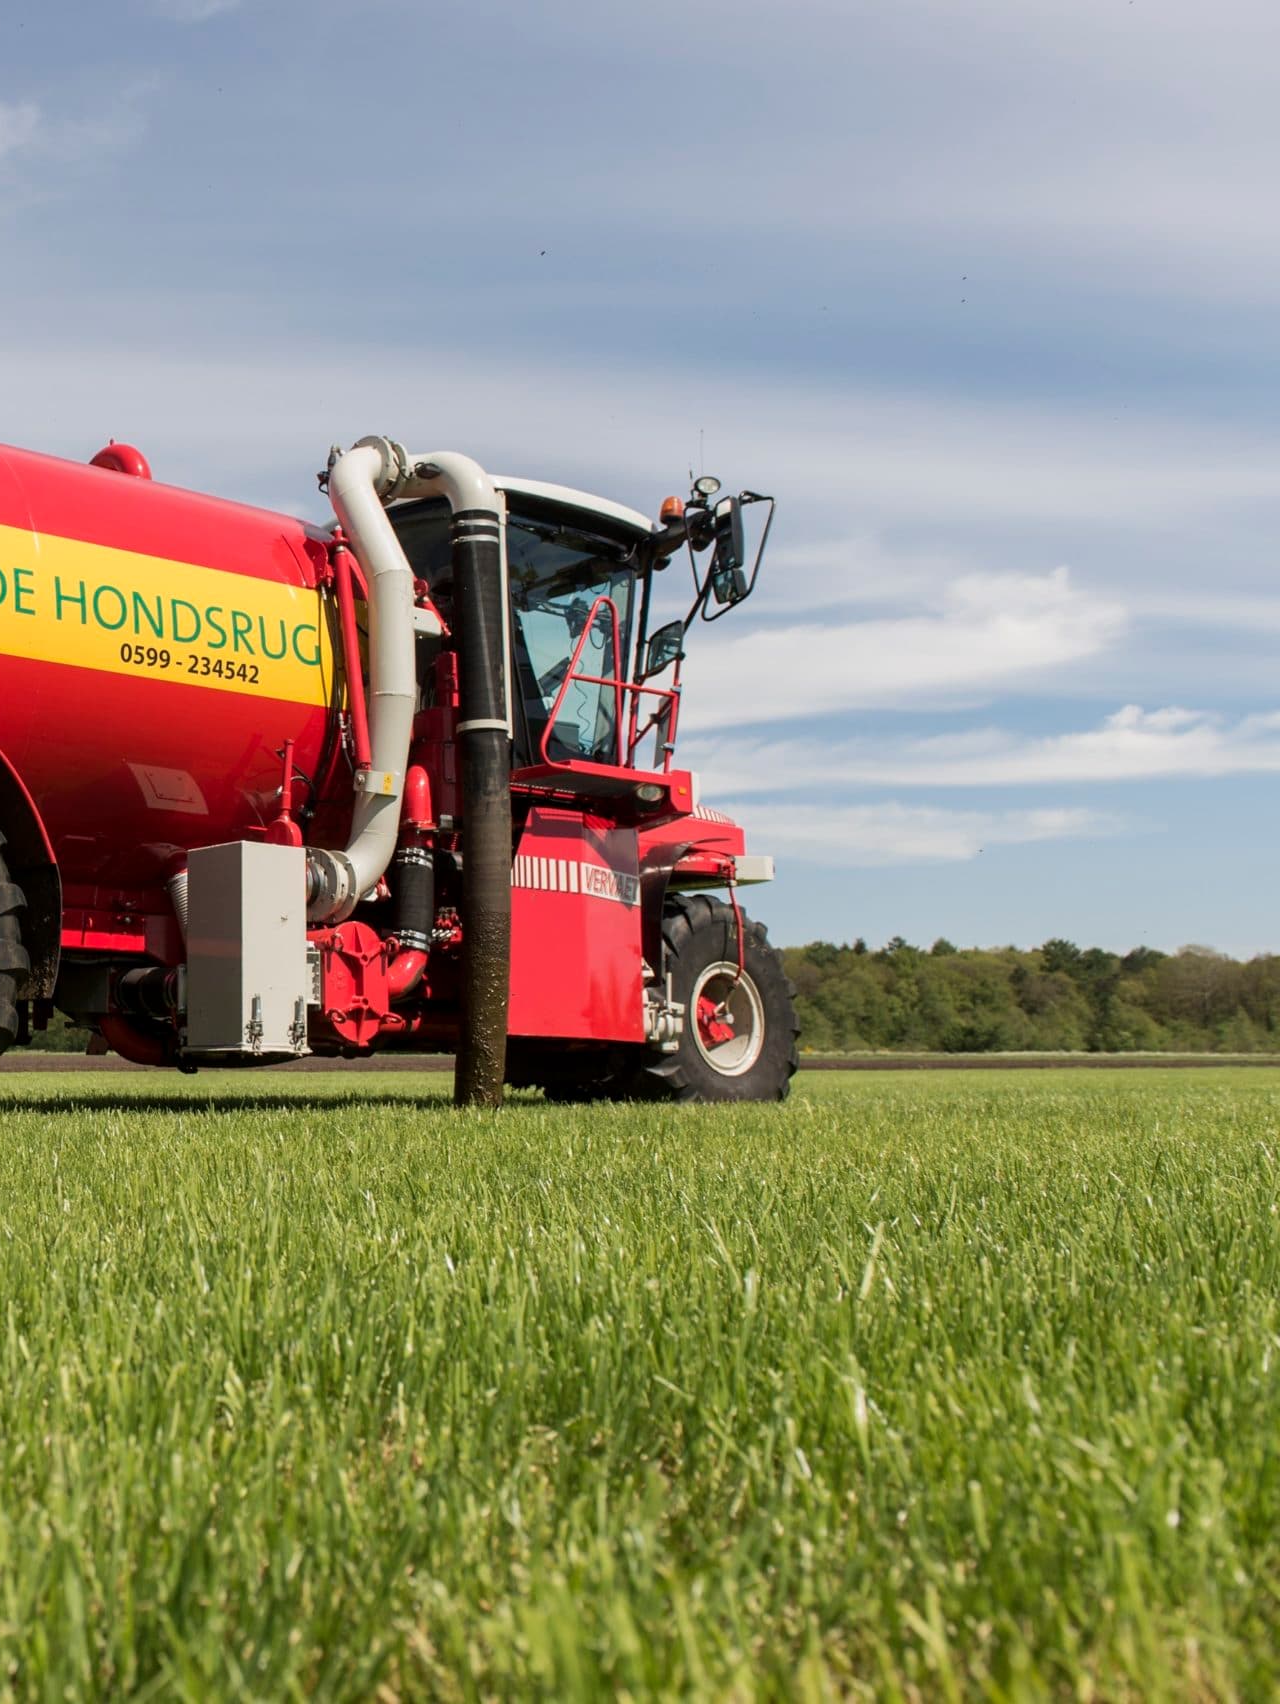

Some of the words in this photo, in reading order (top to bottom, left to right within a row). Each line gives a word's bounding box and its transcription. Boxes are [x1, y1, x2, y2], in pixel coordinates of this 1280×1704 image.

[54, 576, 320, 665] HONDSRUG
[120, 643, 170, 668] 0599
[187, 654, 259, 684] 234542
